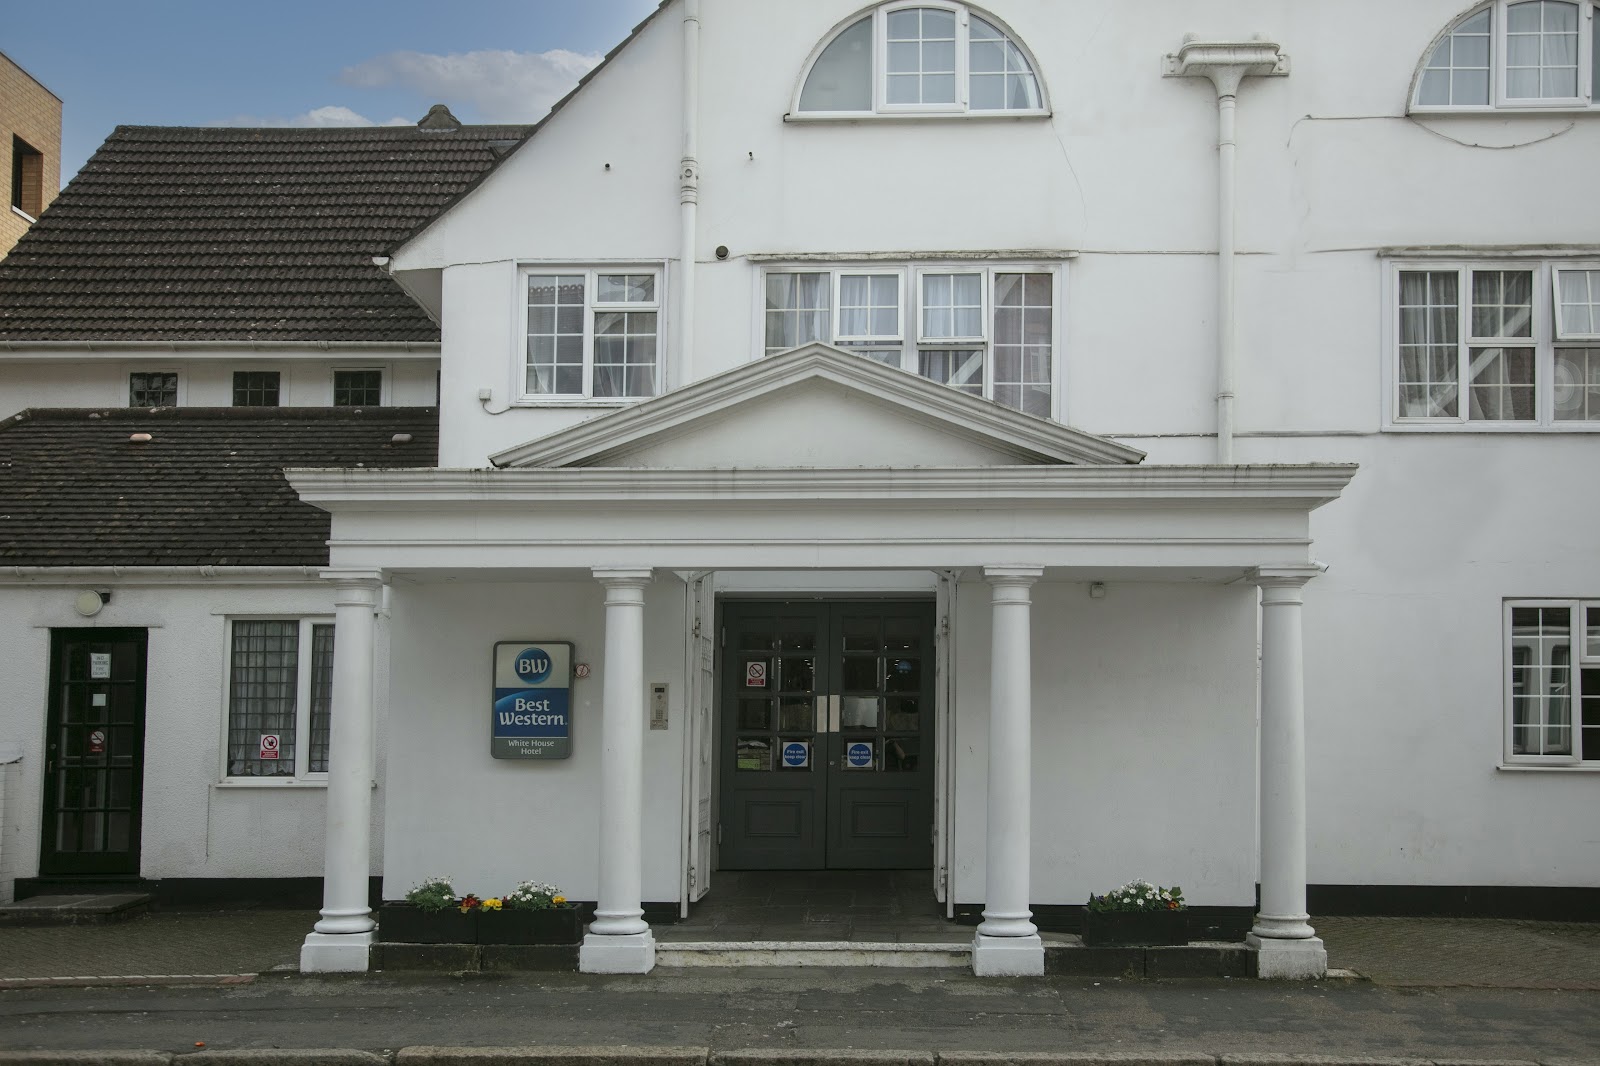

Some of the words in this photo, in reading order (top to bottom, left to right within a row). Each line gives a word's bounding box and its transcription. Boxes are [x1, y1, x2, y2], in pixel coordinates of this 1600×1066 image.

[519, 659, 548, 674] BW
[515, 698, 550, 711] Best
[499, 712, 564, 725] Western
[508, 739, 530, 747] White
[531, 739, 555, 747] House
